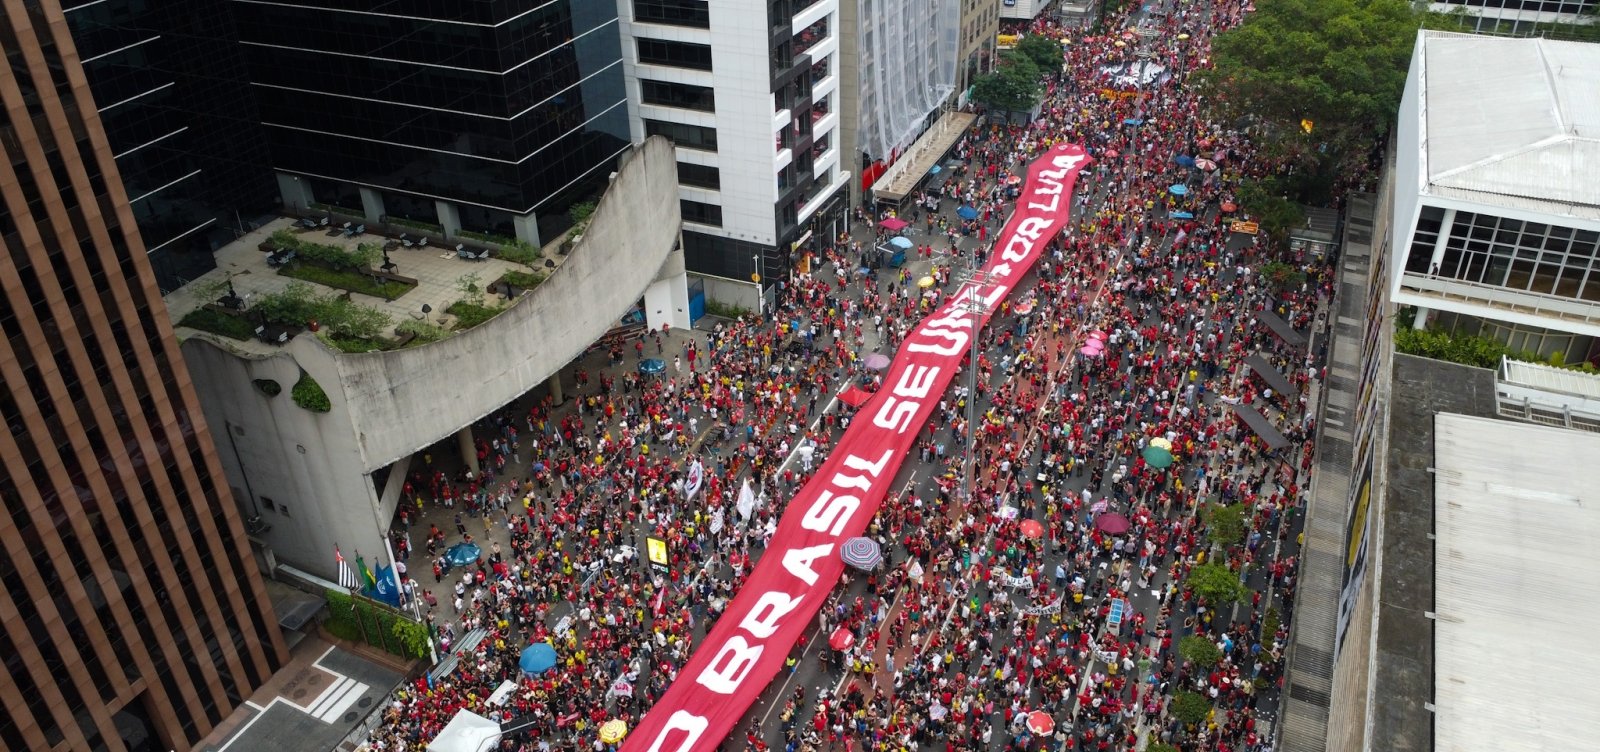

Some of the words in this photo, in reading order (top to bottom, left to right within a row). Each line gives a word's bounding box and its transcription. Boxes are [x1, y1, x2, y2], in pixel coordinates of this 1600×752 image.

[695, 449, 894, 694] BRASIL
[872, 363, 941, 434] SE
[1027, 154, 1086, 212] LULA
